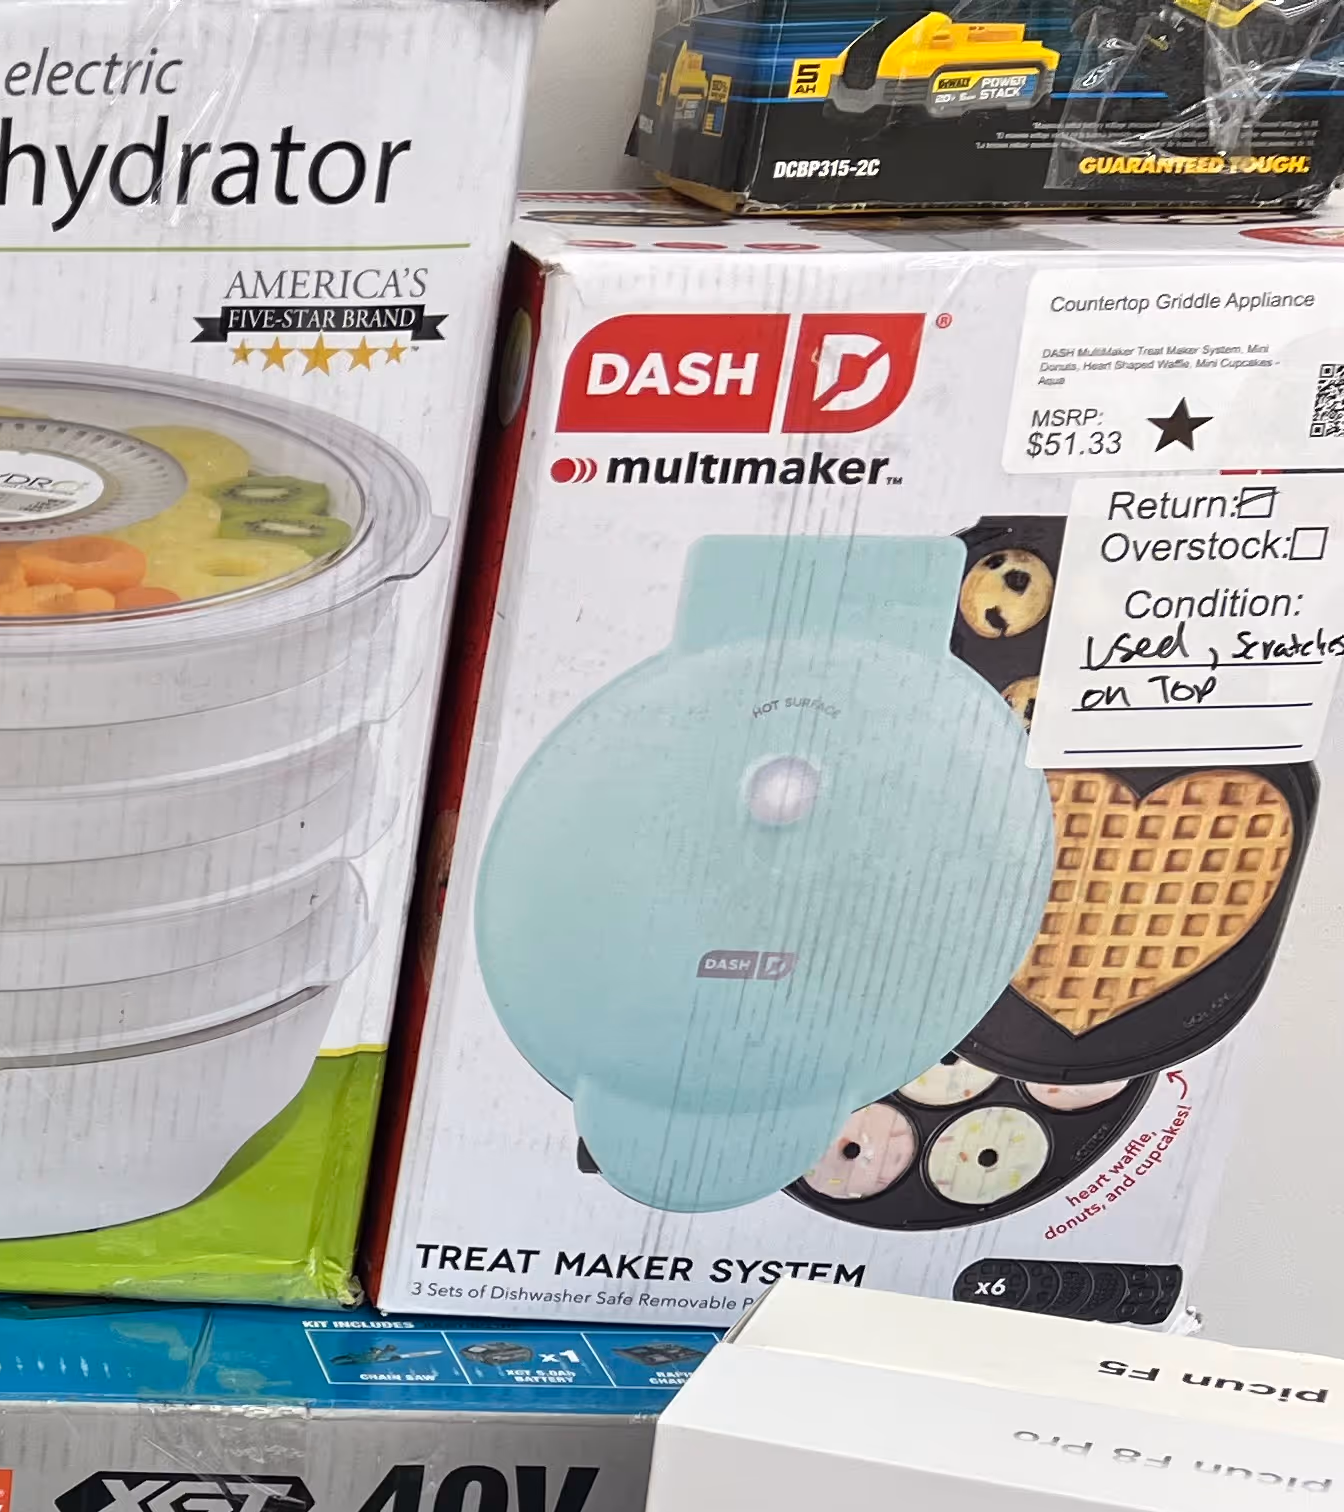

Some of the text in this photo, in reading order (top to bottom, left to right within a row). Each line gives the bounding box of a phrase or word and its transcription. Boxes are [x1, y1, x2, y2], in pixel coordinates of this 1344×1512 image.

[5, 49, 182, 98] electric
[773, 159, 880, 179] DCBP315-2C
[1051, 292, 1315, 314] Countertop Griddle Appliance
[228, 308, 416, 332] FIVE-STAR BRAND
[587, 352, 759, 396] DASH
[1032, 408, 1103, 427] MSRP:
[1027, 431, 1122, 457] $51.33
[607, 451, 889, 485] multimaker
[1108, 492, 1237, 520] Return:
[1101, 530, 1291, 562] Overstock:
[1125, 589, 1303, 618] Condition:
[1066, 1131, 1157, 1207] heart waffle,
[415, 1244, 693, 1282] TREAT MAKER
[974, 1279, 1007, 1296] x6
[1099, 1360, 1329, 1403] picun F5
